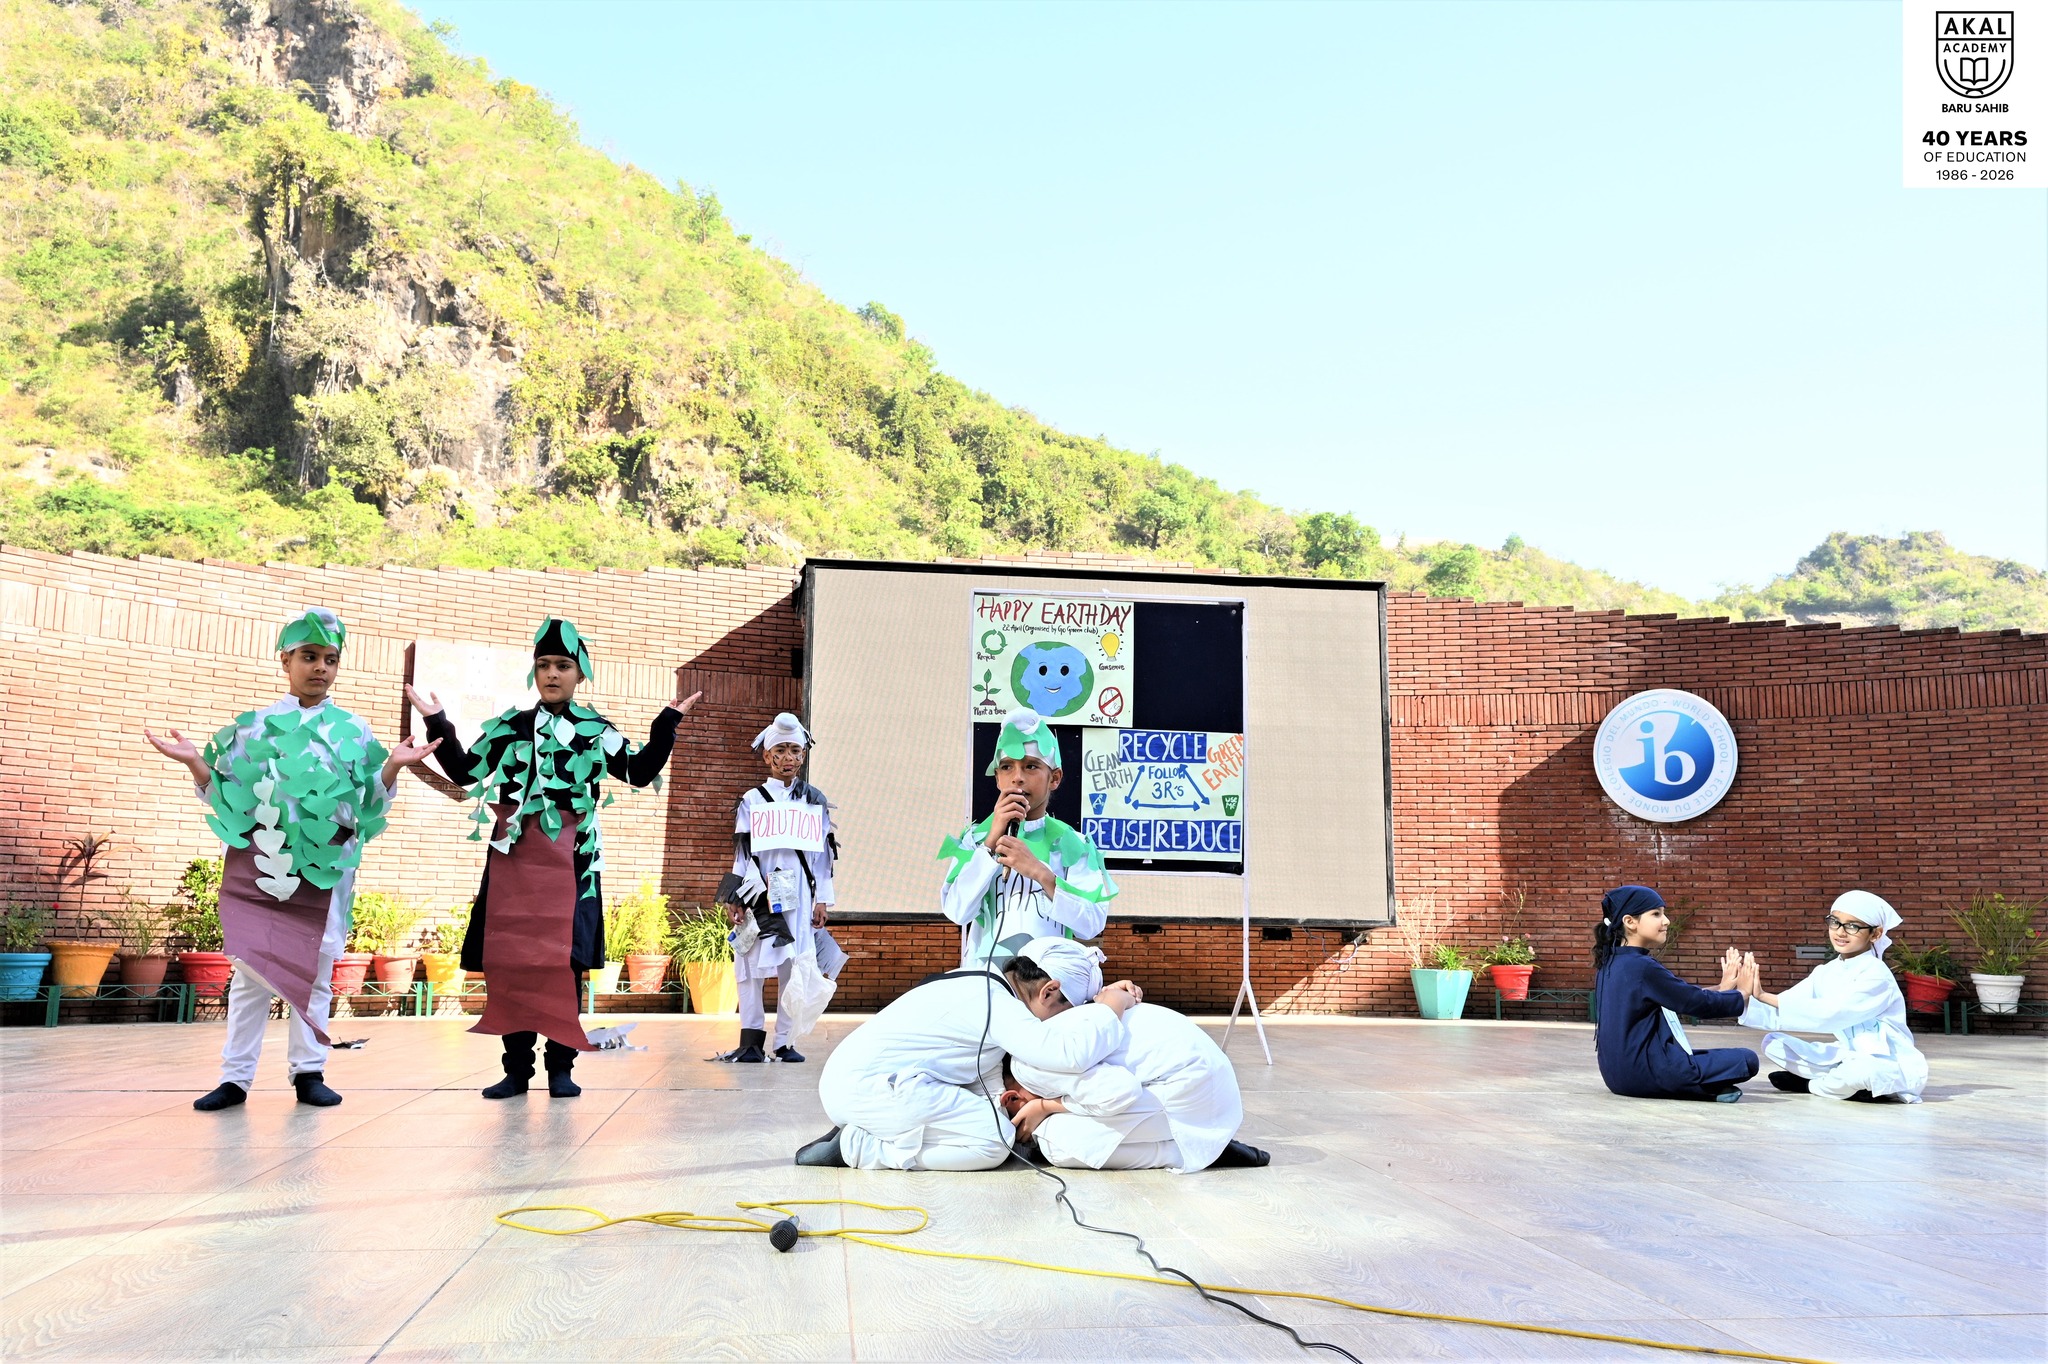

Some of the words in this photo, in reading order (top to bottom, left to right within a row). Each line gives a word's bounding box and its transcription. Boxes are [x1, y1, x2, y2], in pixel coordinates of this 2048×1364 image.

[977, 597, 1033, 623] HAPPY
[1010, 624, 1022, 633] April
[1051, 625, 1056, 634] by
[976, 651, 996, 662] Recycle
[1619, 699, 1659, 722] MUNDO
[1607, 725, 1621, 742] DEL
[1673, 699, 1710, 721] WORLD
[1709, 722, 1728, 764] SCHOOL
[1084, 750, 1122, 772] CLEAN
[1119, 732, 1206, 762] RECYCLE
[1207, 733, 1244, 764] GREEN
[1636, 720, 1696, 786] ib
[1092, 767, 1133, 792] EARTH
[1202, 751, 1244, 791] EARTH
[1603, 746, 1621, 791] COLEGIO
[1628, 796, 1670, 814] MONDE
[1675, 803, 1691, 814] DU
[752, 809, 821, 842] POLLUTION
[1086, 819, 1151, 849] REUSE
[1155, 820, 1241, 851] REDUCE
[995, 872, 1064, 935] EAR
